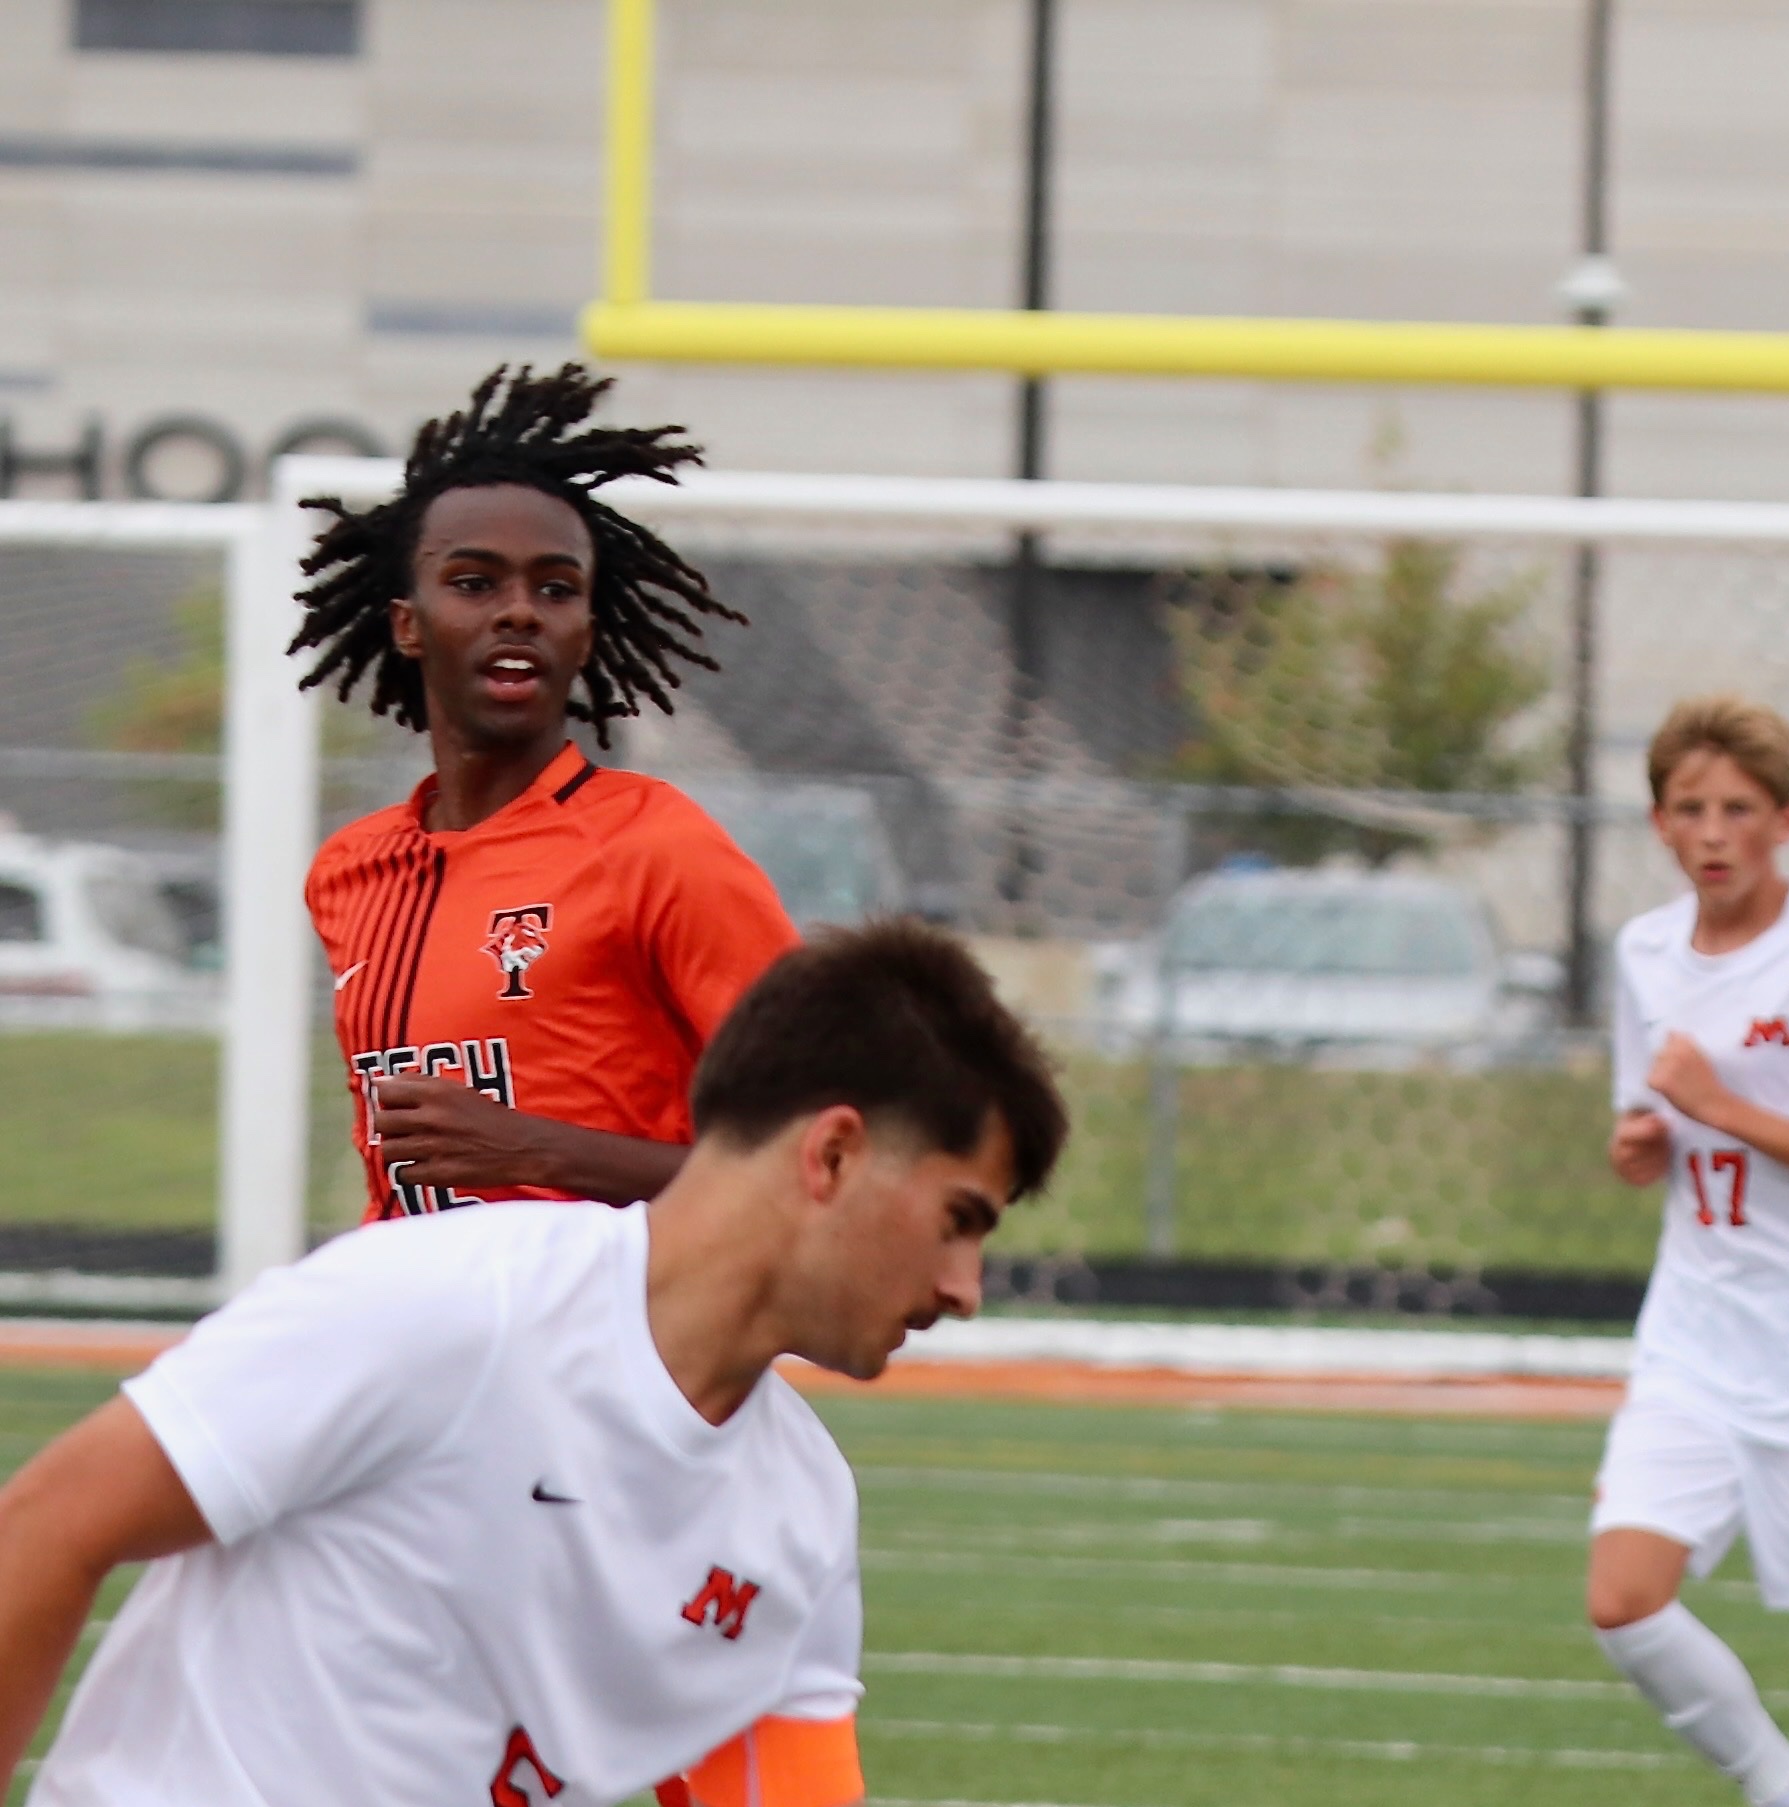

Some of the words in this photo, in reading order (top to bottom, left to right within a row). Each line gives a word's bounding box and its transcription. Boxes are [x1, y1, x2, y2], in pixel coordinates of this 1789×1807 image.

[350, 1038, 516, 1146] TH
[1688, 1151, 1746, 1225] 17
[680, 1565, 760, 1641] M
